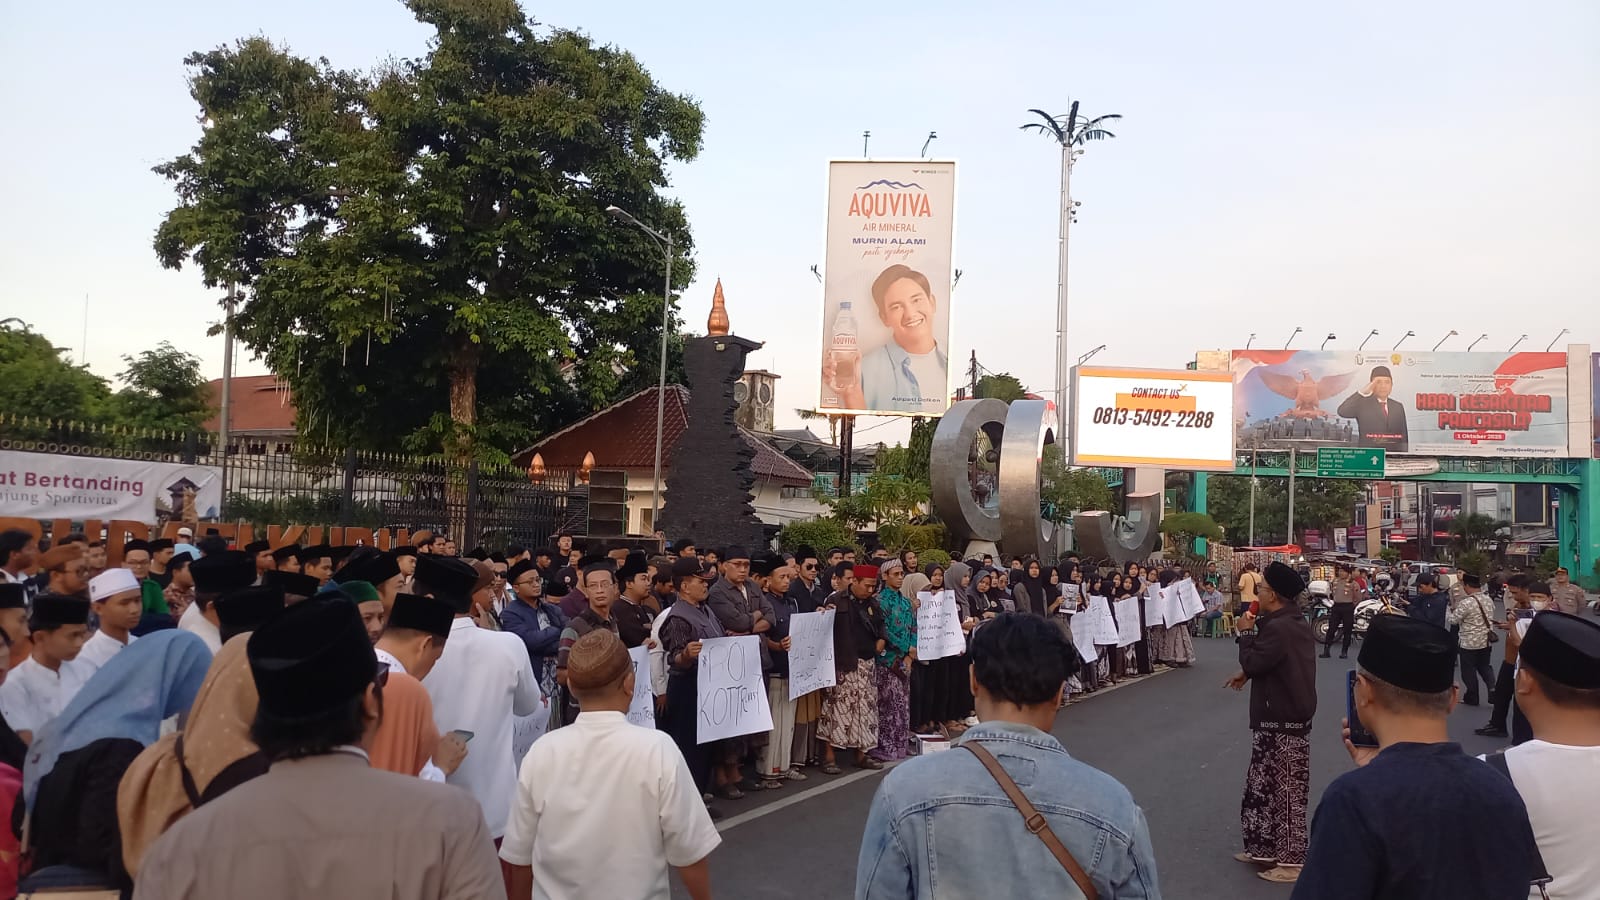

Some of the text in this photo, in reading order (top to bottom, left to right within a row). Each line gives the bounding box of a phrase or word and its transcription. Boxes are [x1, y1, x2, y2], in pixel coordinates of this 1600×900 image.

[848, 192, 932, 219] AQUVIVA
[862, 223, 917, 233] AIR MINERAL
[852, 237, 927, 246] MURNI ALAMI
[1131, 387, 1181, 400] CONTACT US
[1416, 393, 1456, 411] HARI
[1093, 406, 1214, 429] 0813-5492-2288
[1438, 412, 1531, 431] PANCASILA
[24, 472, 144, 497] Bertanding
[46, 490, 118, 507] Sportivitas
